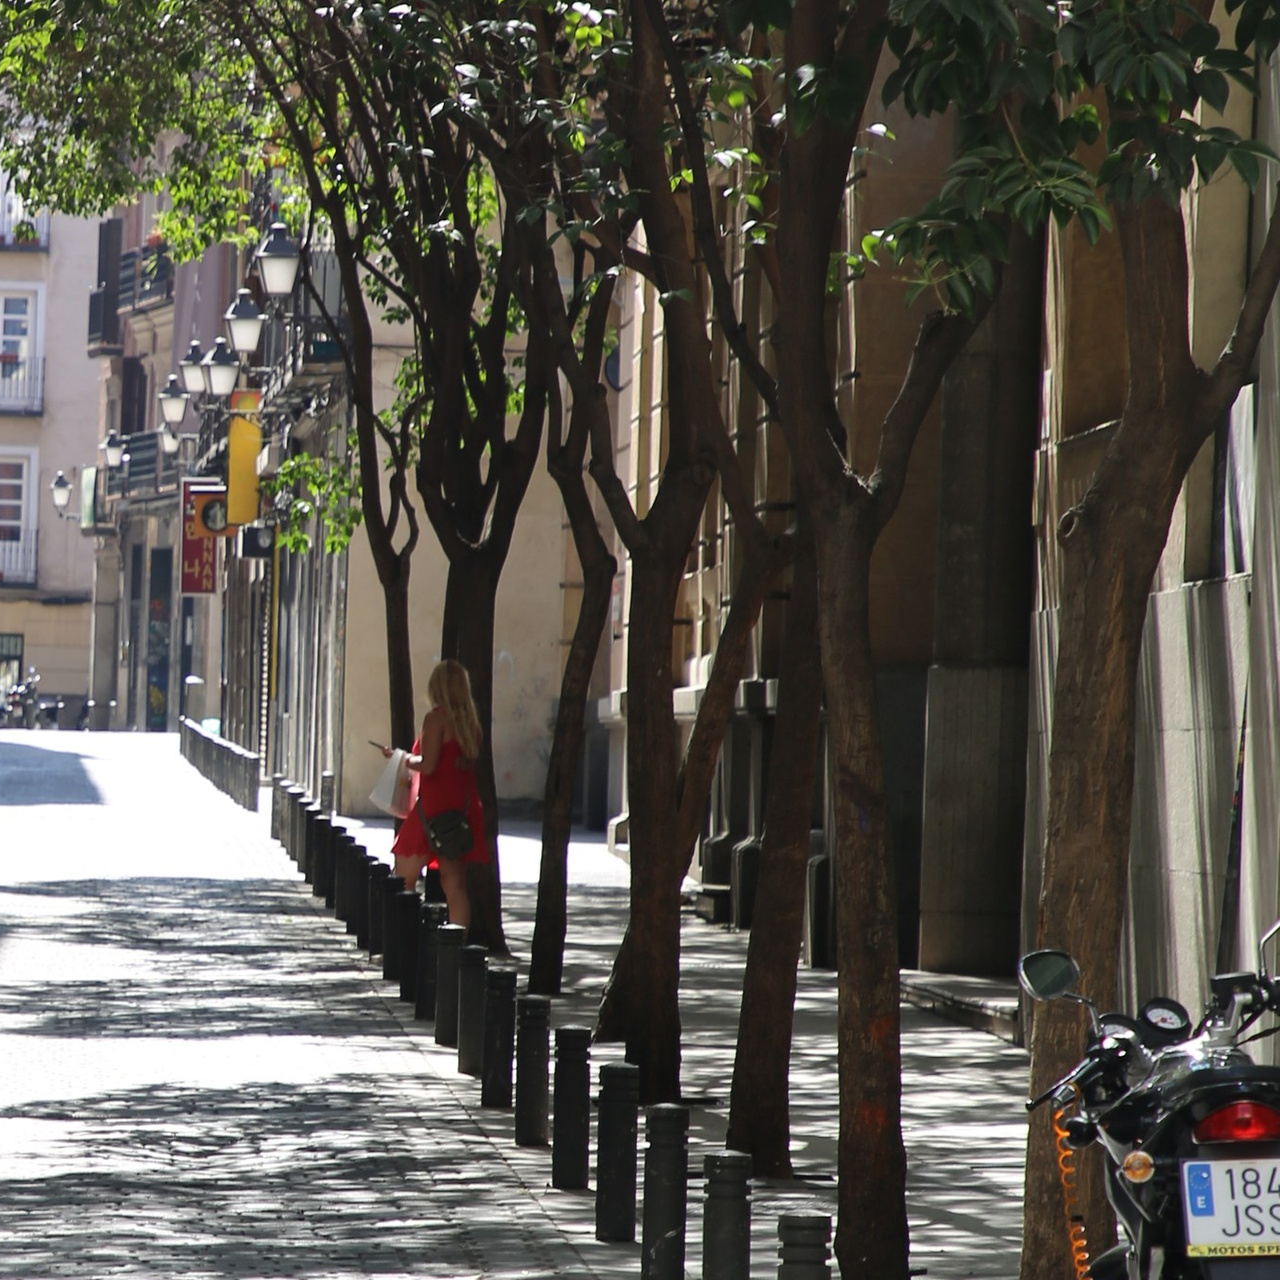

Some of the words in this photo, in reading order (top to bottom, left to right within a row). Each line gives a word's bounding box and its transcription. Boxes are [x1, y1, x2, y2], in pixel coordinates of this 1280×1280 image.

[1225, 1166, 1280, 1200] 184
[1197, 1196, 1206, 1209] E
[1222, 1204, 1280, 1237] JSS
[1208, 1246, 1255, 1255] MOTOS
